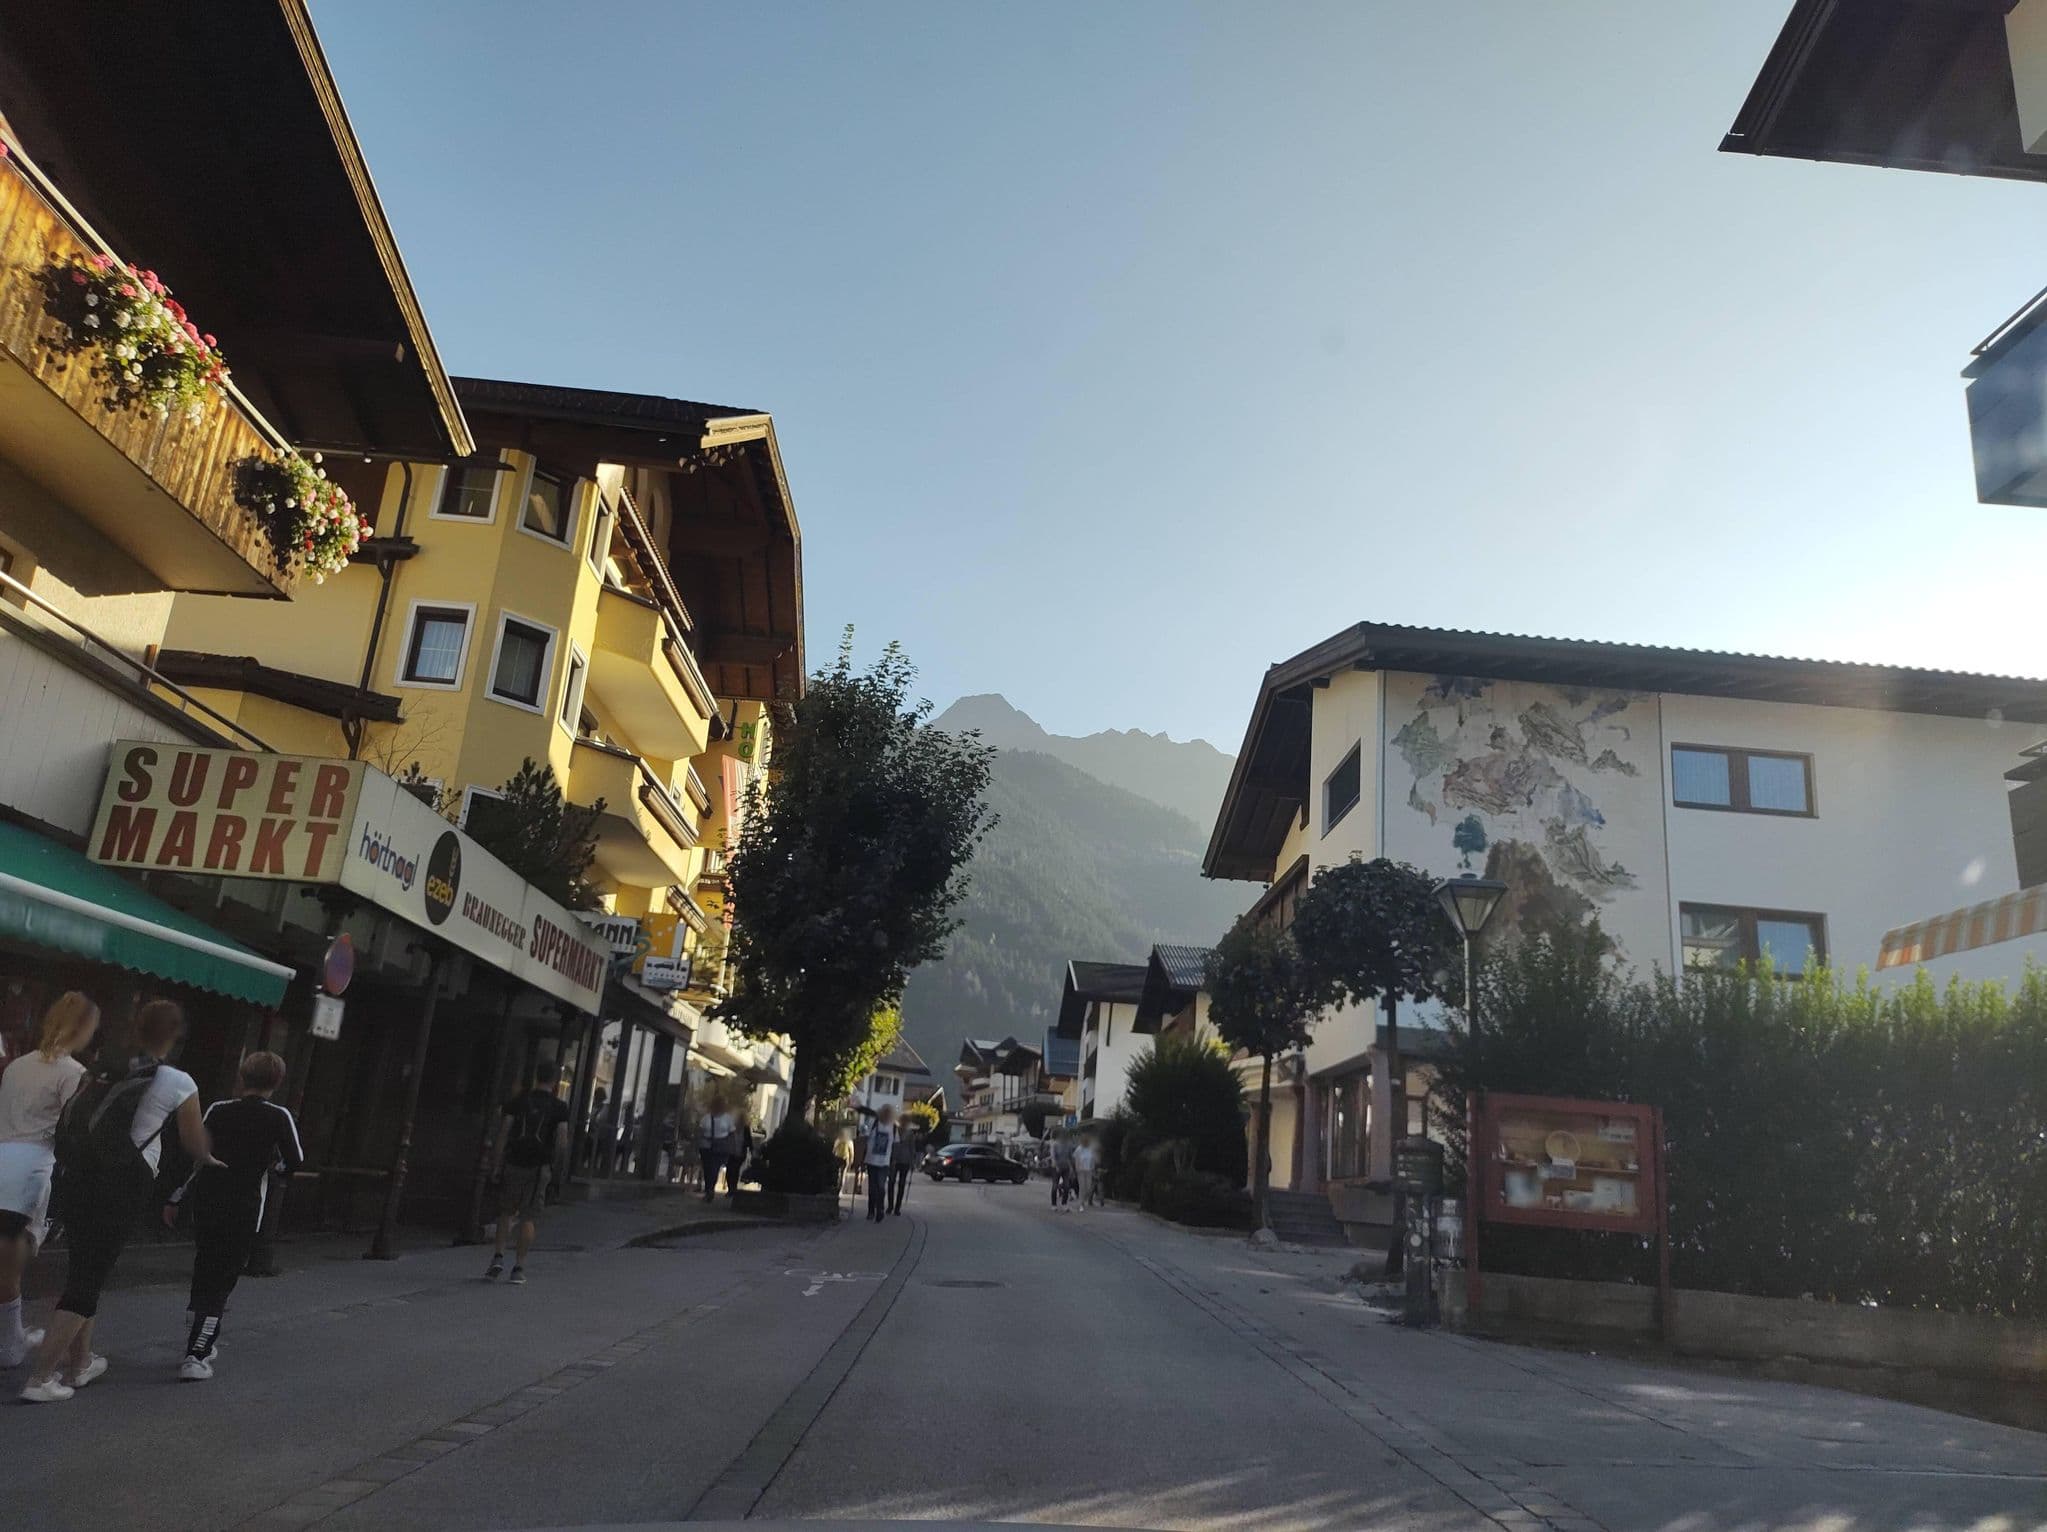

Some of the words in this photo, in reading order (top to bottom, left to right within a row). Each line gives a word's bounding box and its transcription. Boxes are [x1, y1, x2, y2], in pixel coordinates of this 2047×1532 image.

[117, 747, 350, 818] SUPER
[98, 805, 339, 877] MARKT
[359, 821, 420, 892] hörtnagl
[427, 875, 454, 907] ezeb
[530, 914, 605, 993] SUPERMARKT
